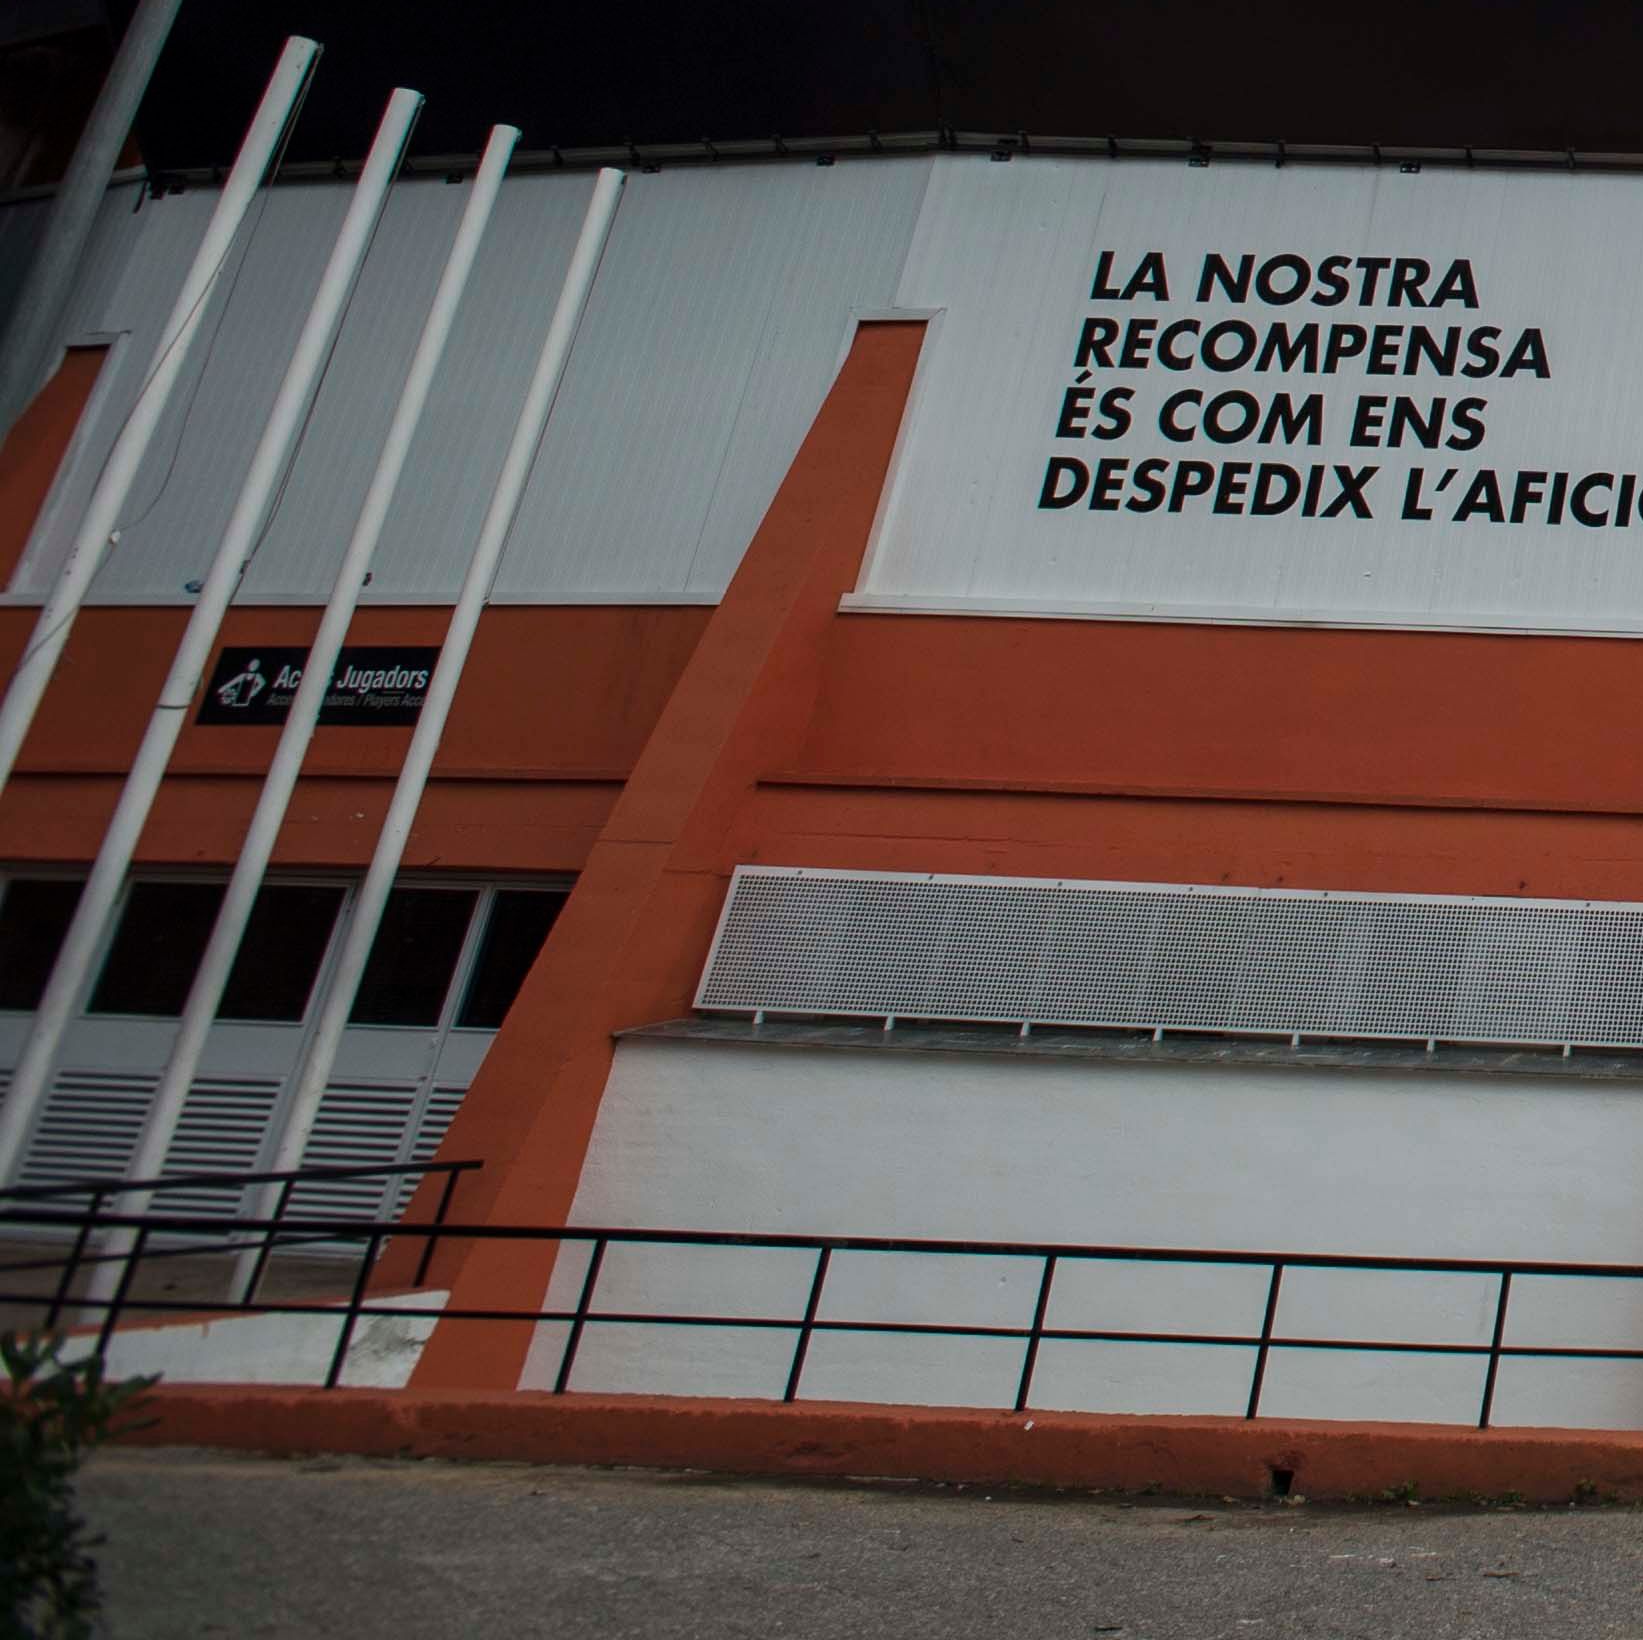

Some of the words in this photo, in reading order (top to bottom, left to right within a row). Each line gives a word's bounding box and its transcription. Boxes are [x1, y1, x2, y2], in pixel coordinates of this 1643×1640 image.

[1090, 251, 1170, 302] LA
[1195, 253, 1480, 310] NOSTRA
[1073, 318, 1551, 379] RECOMPENSA
[1055, 370, 1135, 441] ÉS
[1158, 388, 1324, 446] COM
[1350, 395, 1488, 452] ENS
[1037, 457, 1379, 520] DESPEDIX
[337, 665, 429, 694] Jugadors
